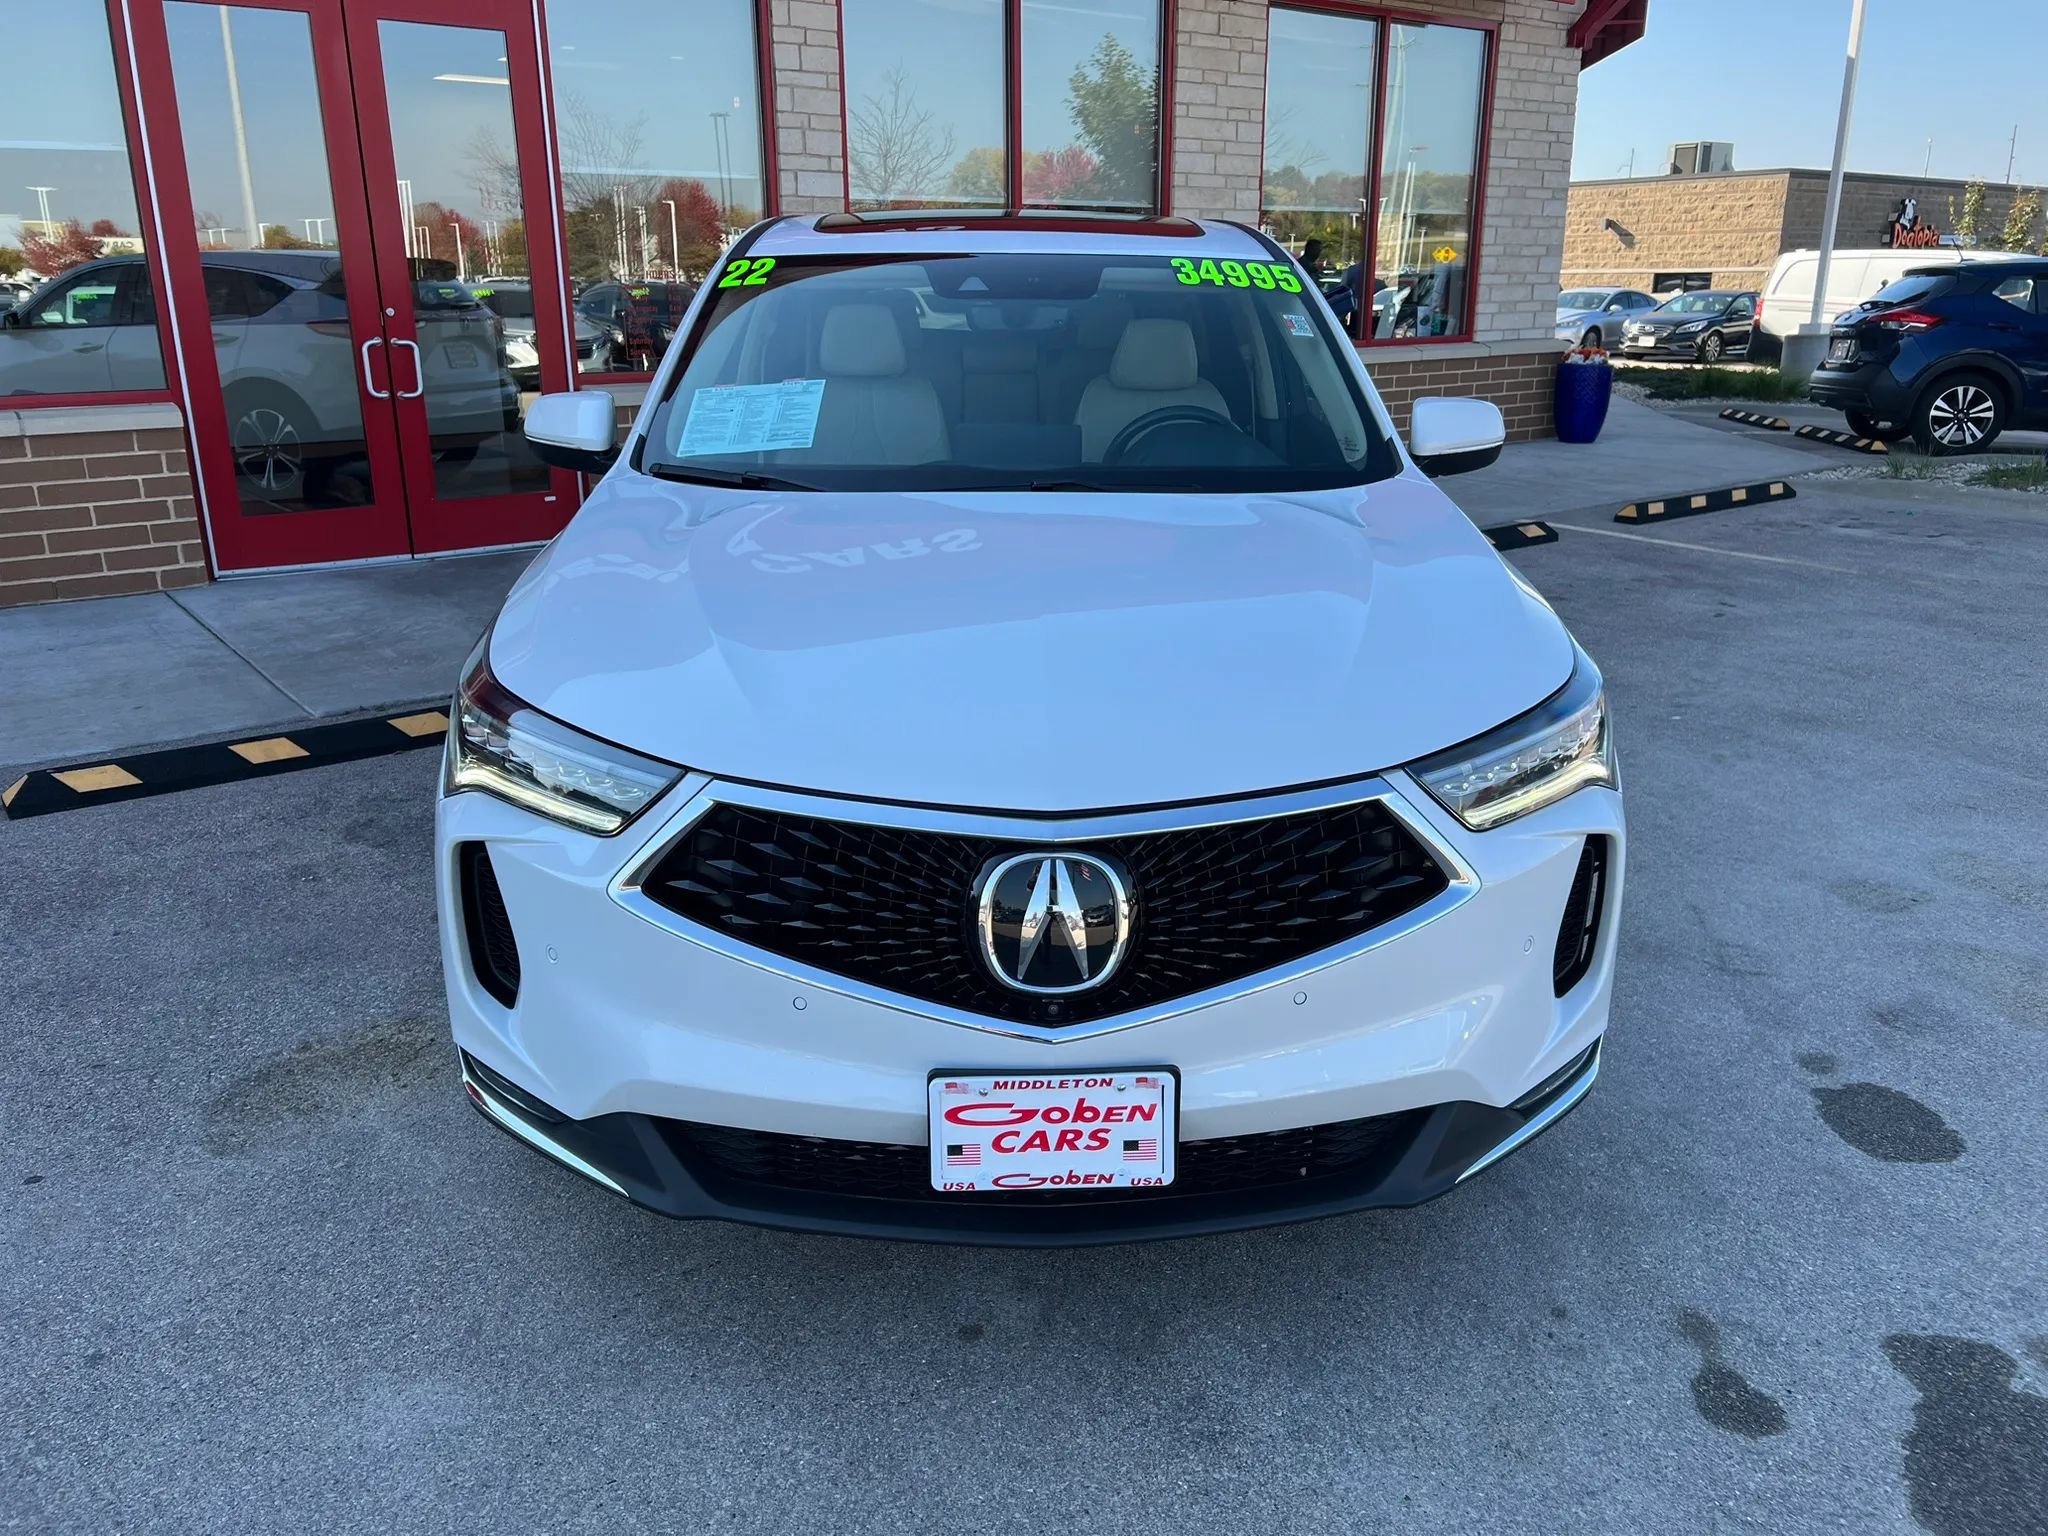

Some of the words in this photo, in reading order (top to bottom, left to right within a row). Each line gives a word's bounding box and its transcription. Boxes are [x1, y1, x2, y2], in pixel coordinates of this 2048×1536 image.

[718, 257, 776, 288] 22
[1170, 257, 1303, 294] 34995
[992, 1077, 1114, 1091] MIDDLETON
[991, 1127, 1113, 1154] CARS
[942, 1182, 977, 1191] USA
[1130, 1176, 1164, 1187] USA
